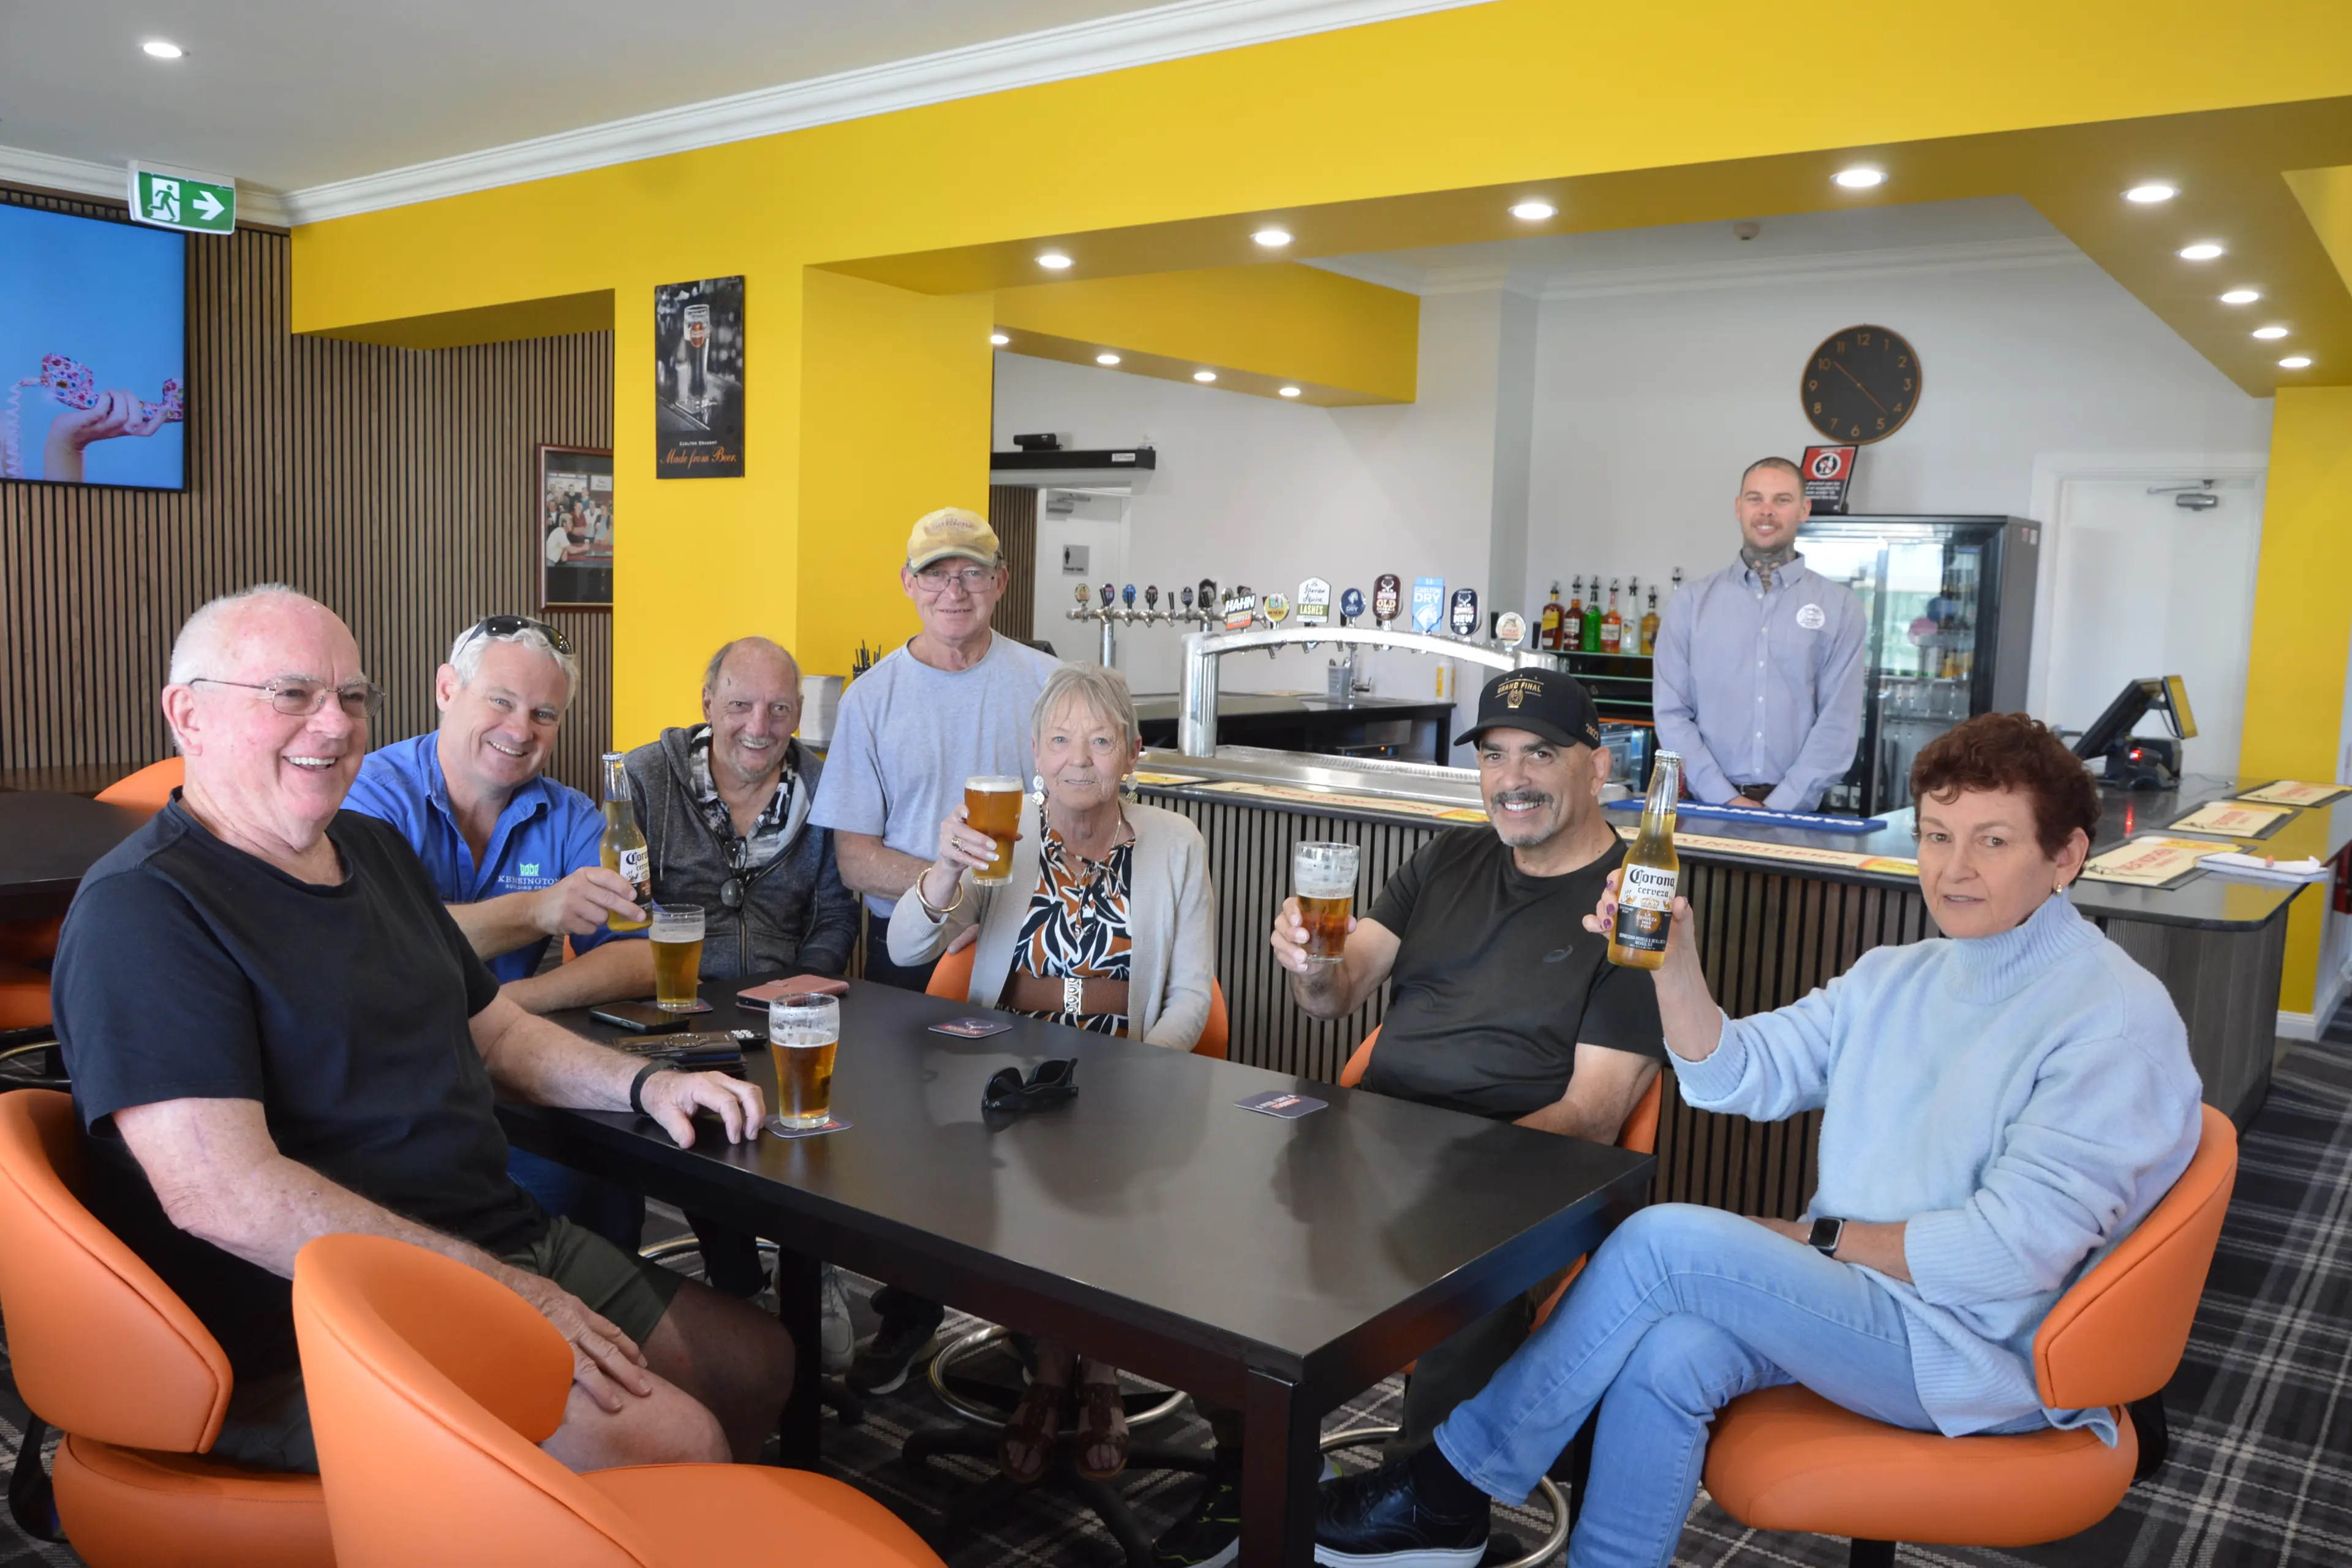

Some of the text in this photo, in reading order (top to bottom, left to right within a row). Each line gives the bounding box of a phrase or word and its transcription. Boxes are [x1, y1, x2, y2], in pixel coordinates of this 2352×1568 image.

[1856, 333, 1871, 346] 12
[1885, 338, 1890, 351] 1
[1837, 341, 1845, 353] 11
[1818, 358, 1831, 371] 10
[1899, 356, 1907, 368] 2
[1809, 380, 1818, 391] 9
[1903, 378, 1912, 391] 3
[1814, 402, 1822, 414] 8
[1893, 402, 1902, 412] 4
[1830, 418, 1838, 430] 7
[1876, 418, 1885, 430] 5
[1851, 425, 1860, 437] 6
[660, 448, 688, 464] Made
[687, 448, 709, 469] from
[1226, 595, 1255, 612] HAHN
[1376, 599, 1396, 608] OLD
[1414, 592, 1441, 604] DRY
[1300, 604, 1324, 616] LASHES
[1453, 614, 1474, 624] NEW
[1497, 681, 1542, 695] GRAND FINAL
[1629, 868, 1675, 890] Corona
[1637, 886, 1669, 898] cerveza
